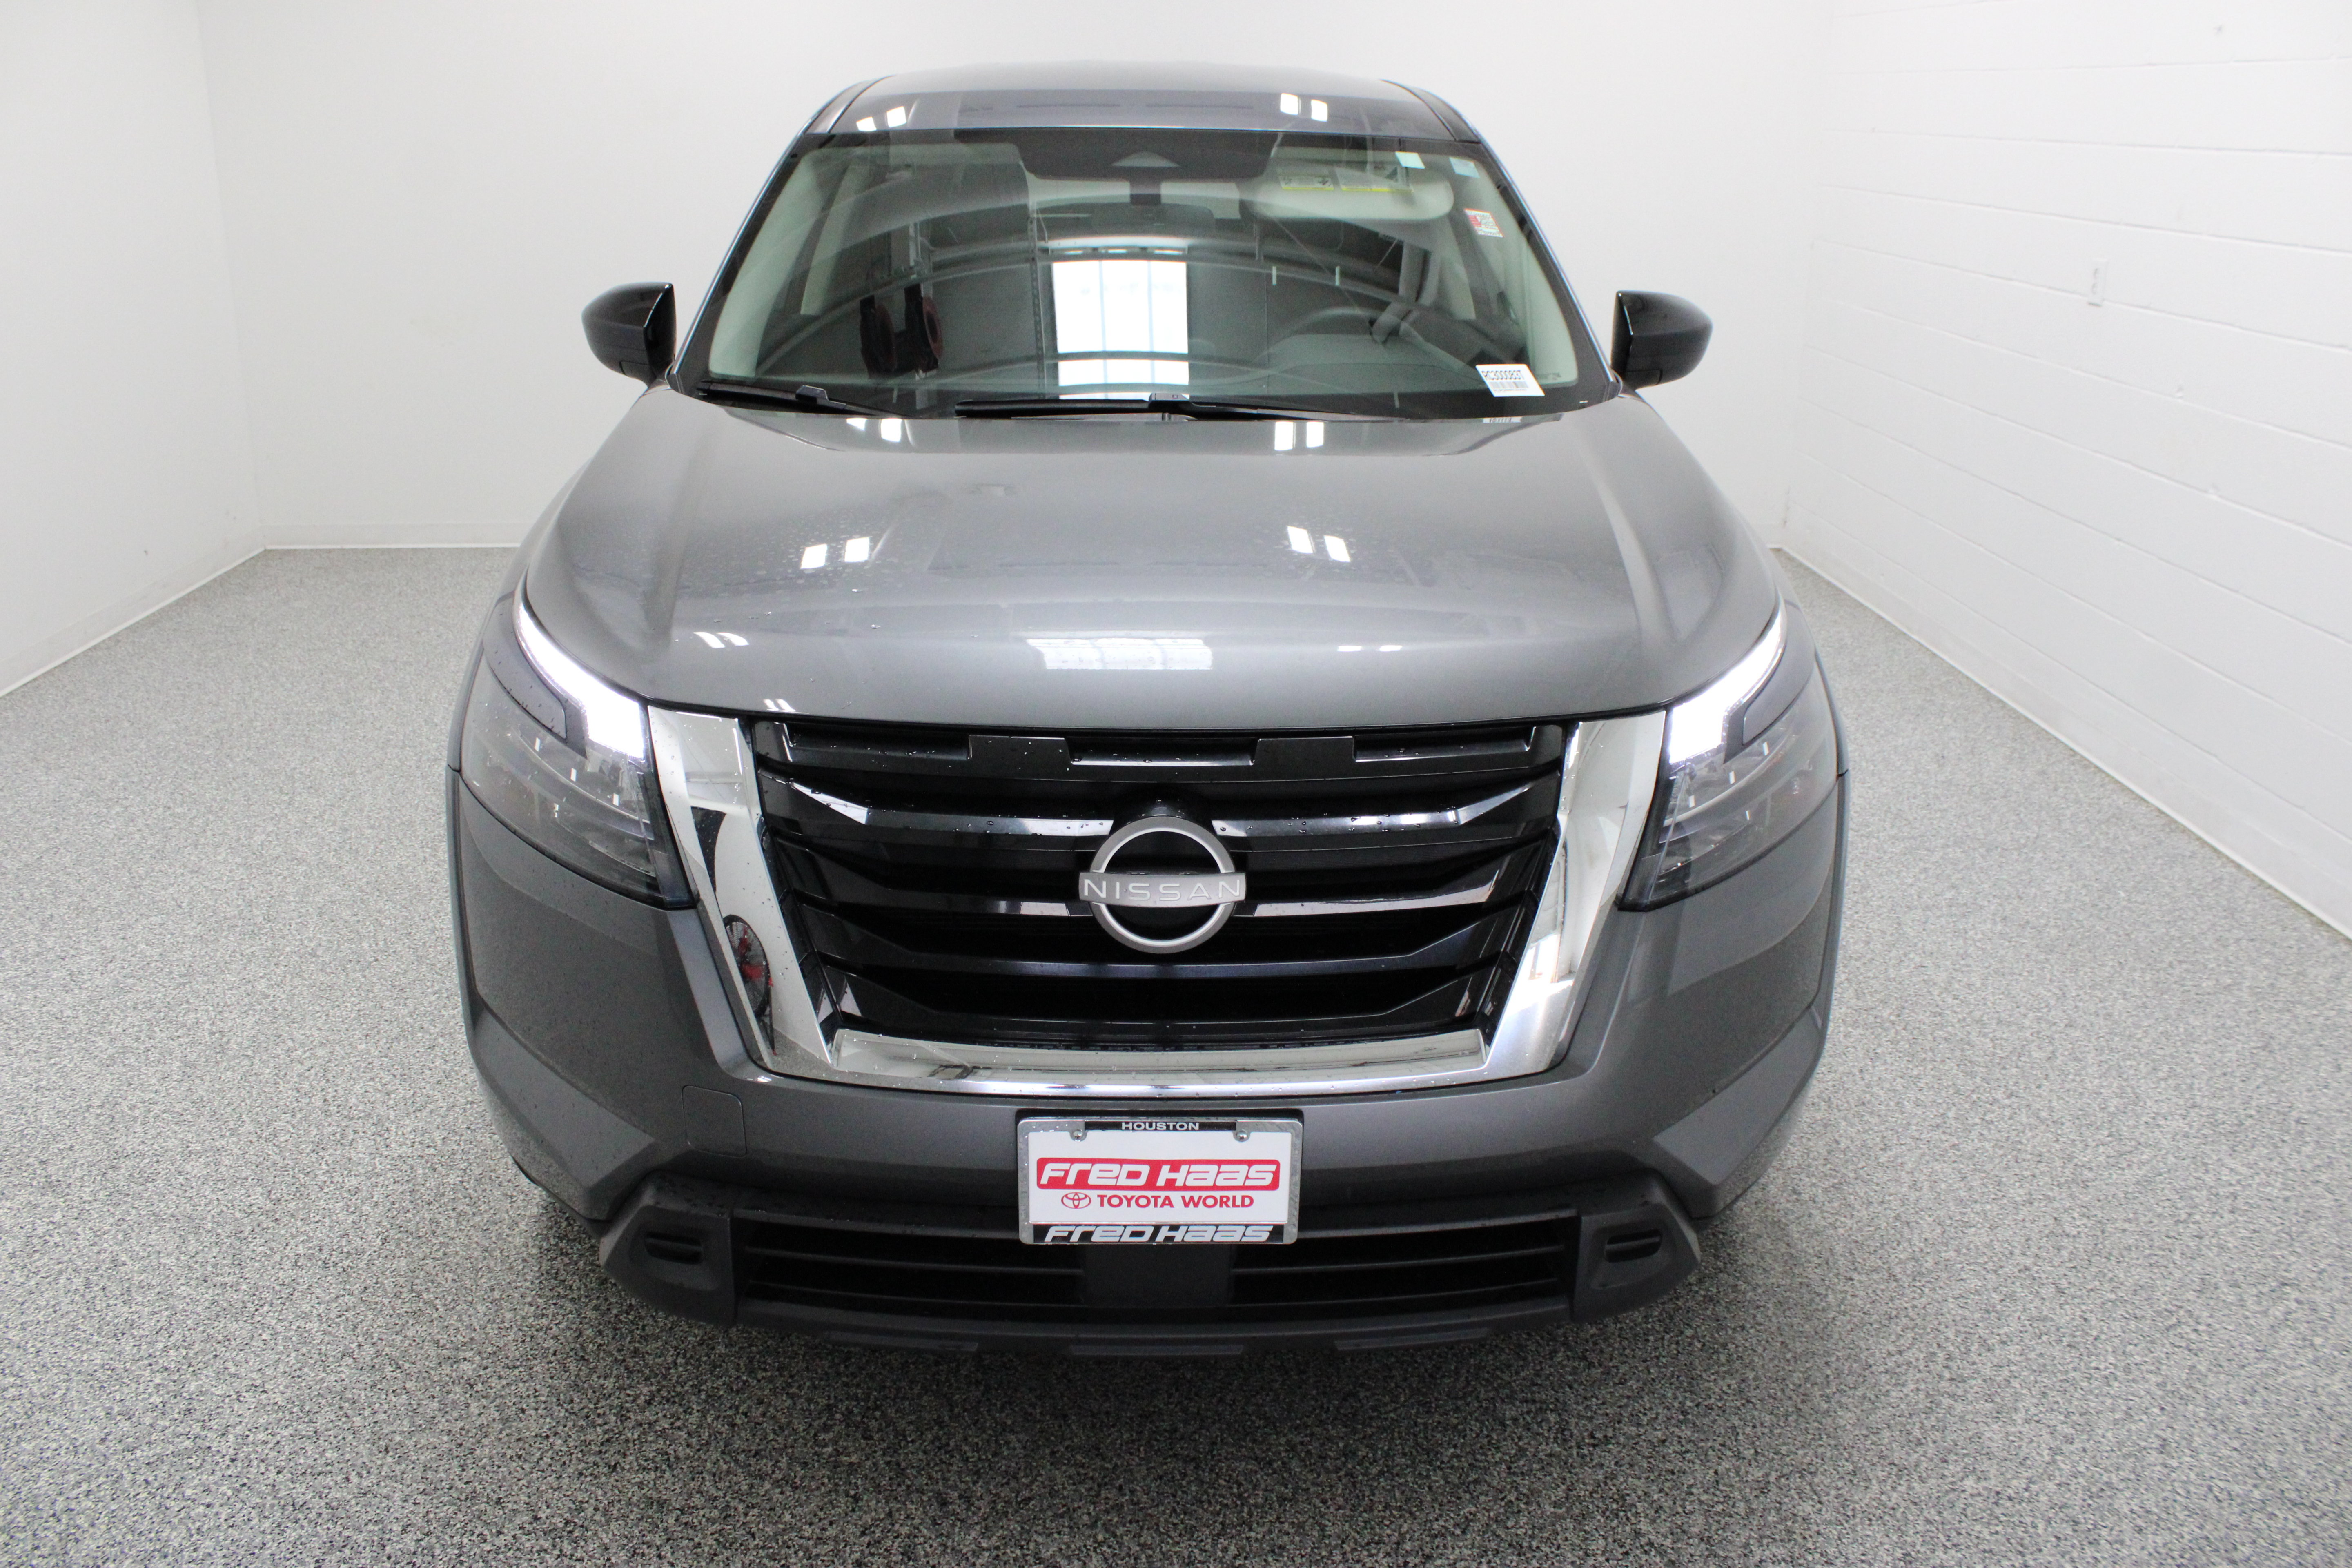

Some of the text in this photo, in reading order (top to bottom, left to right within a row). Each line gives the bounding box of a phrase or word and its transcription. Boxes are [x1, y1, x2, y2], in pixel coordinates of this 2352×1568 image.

[1084, 879, 1240, 901] NISSAN
[1121, 1122, 1199, 1131] HOUSTON
[1097, 1195, 1254, 1208] TOYOTA WORLD
